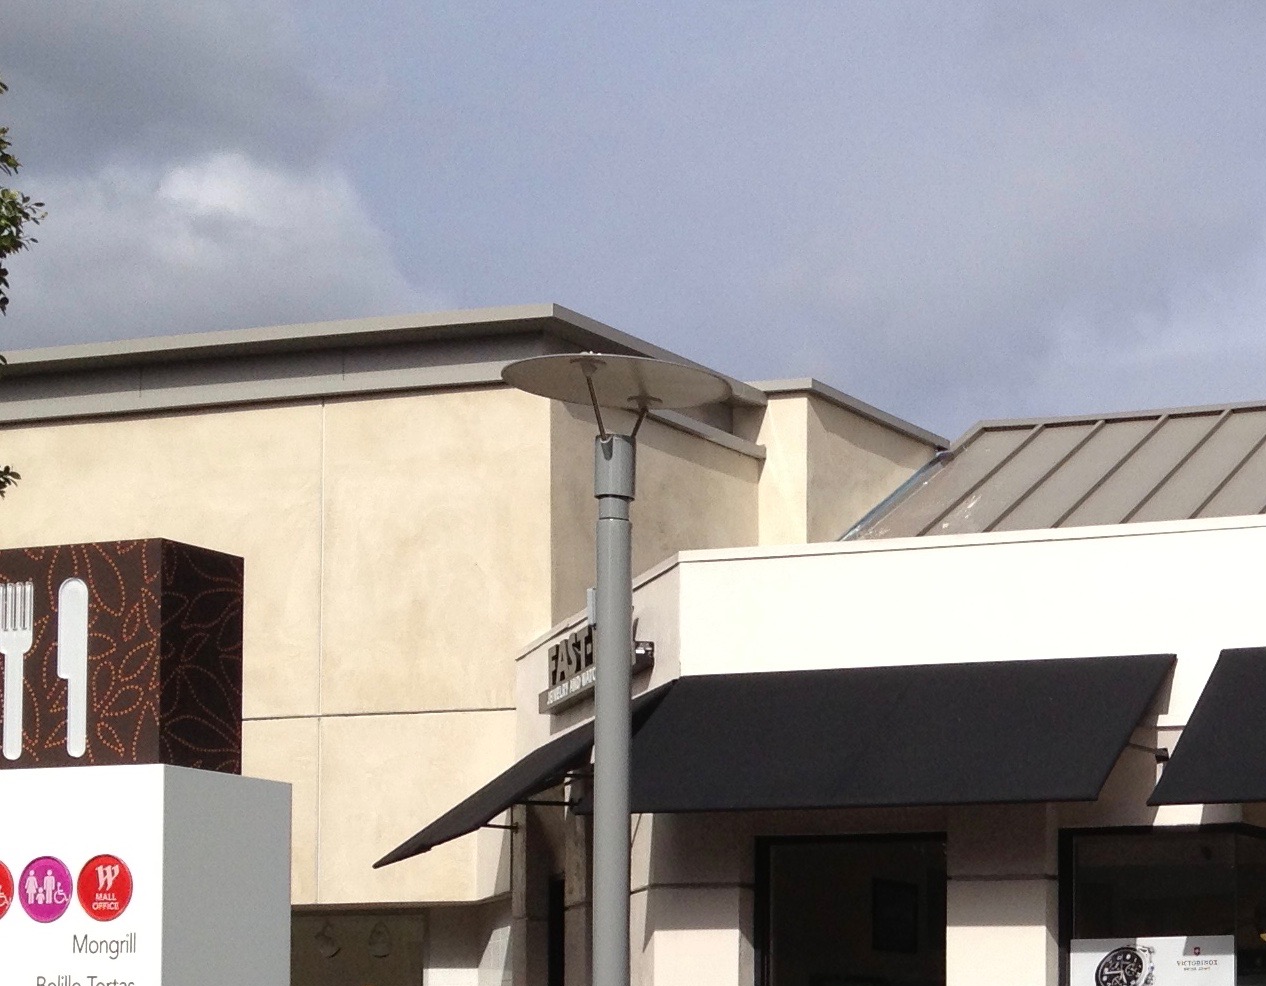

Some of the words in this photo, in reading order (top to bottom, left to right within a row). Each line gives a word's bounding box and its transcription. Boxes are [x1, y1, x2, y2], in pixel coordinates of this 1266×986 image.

[548, 624, 597, 688] FAST-
[581, 666, 597, 687] WATC
[92, 901, 120, 911] OFFICE
[95, 892, 117, 902] MALL
[72, 932, 137, 960] Mongrill
